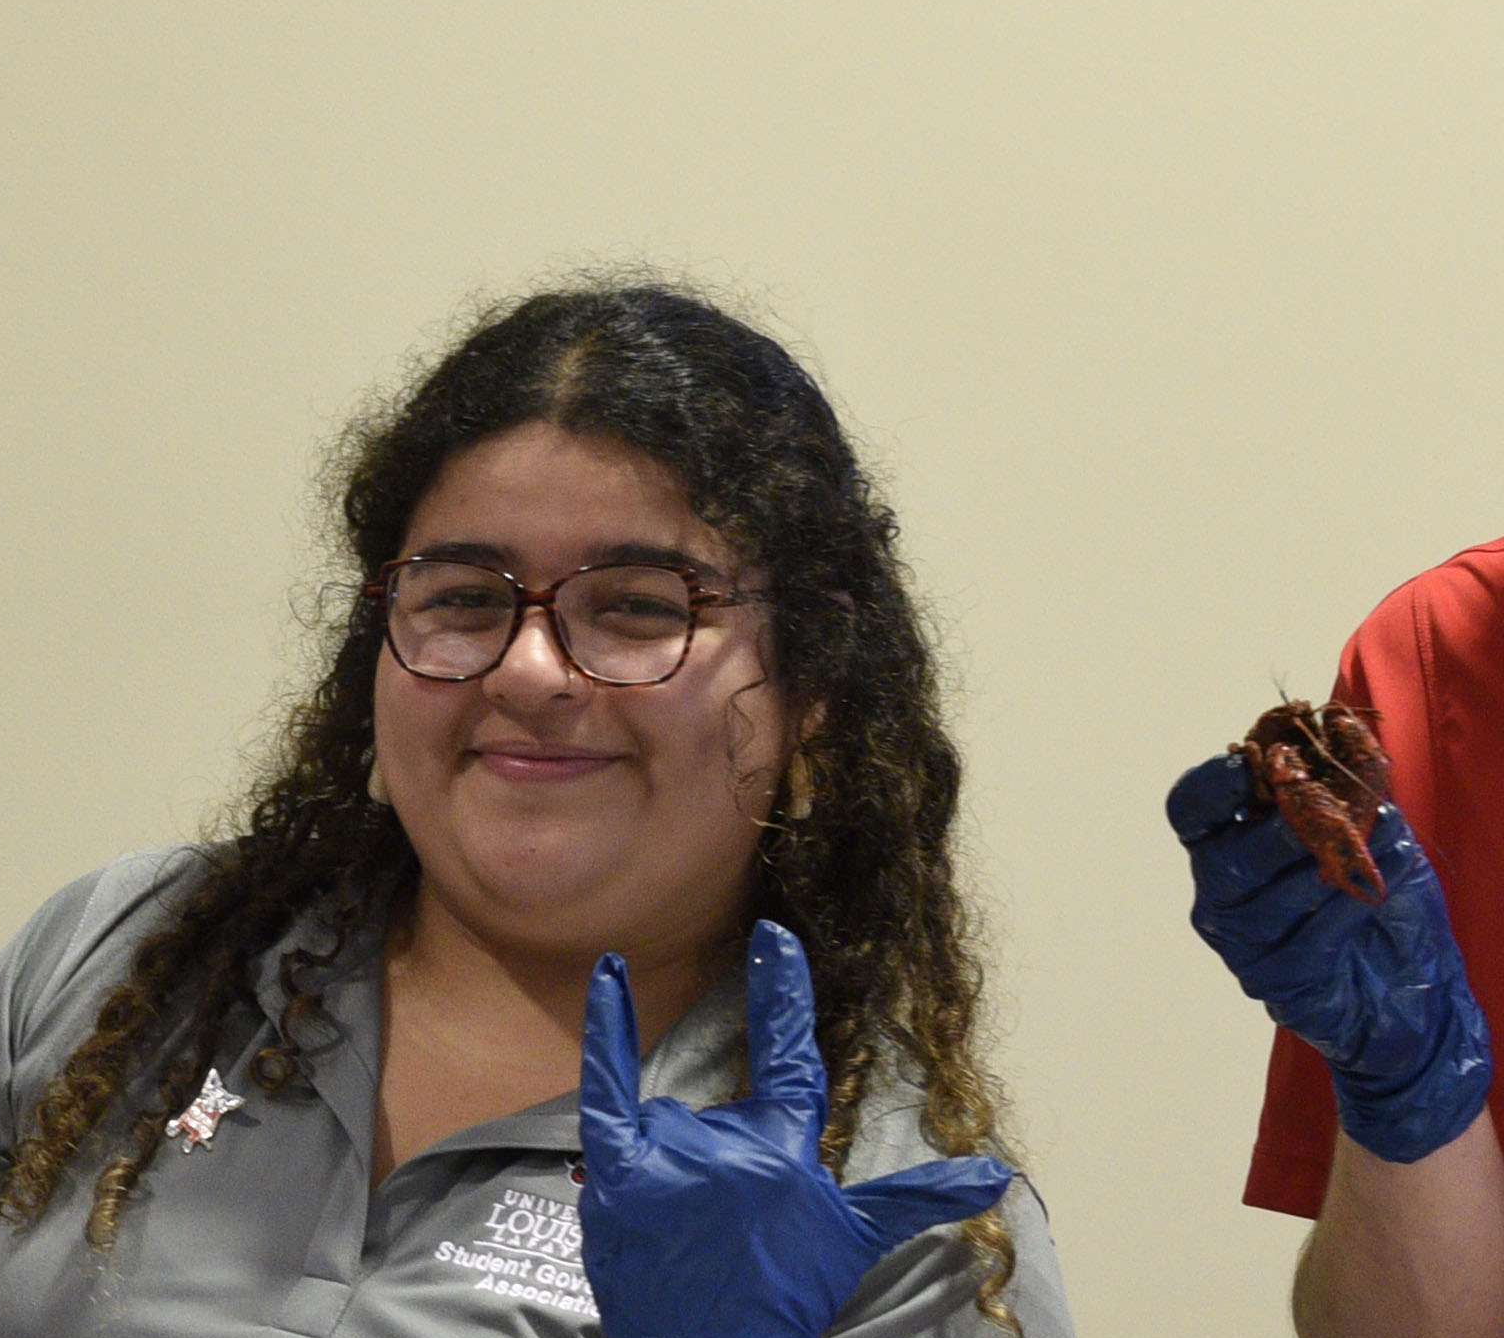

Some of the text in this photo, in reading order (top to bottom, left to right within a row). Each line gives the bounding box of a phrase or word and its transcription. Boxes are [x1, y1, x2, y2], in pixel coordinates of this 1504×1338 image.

[503, 1188, 581, 1223] UNIVE
[484, 1202, 584, 1248] LOUIS
[433, 1240, 533, 1278] Student
[492, 1227, 583, 1263] LAFAY
[473, 1272, 601, 1319] Associati
